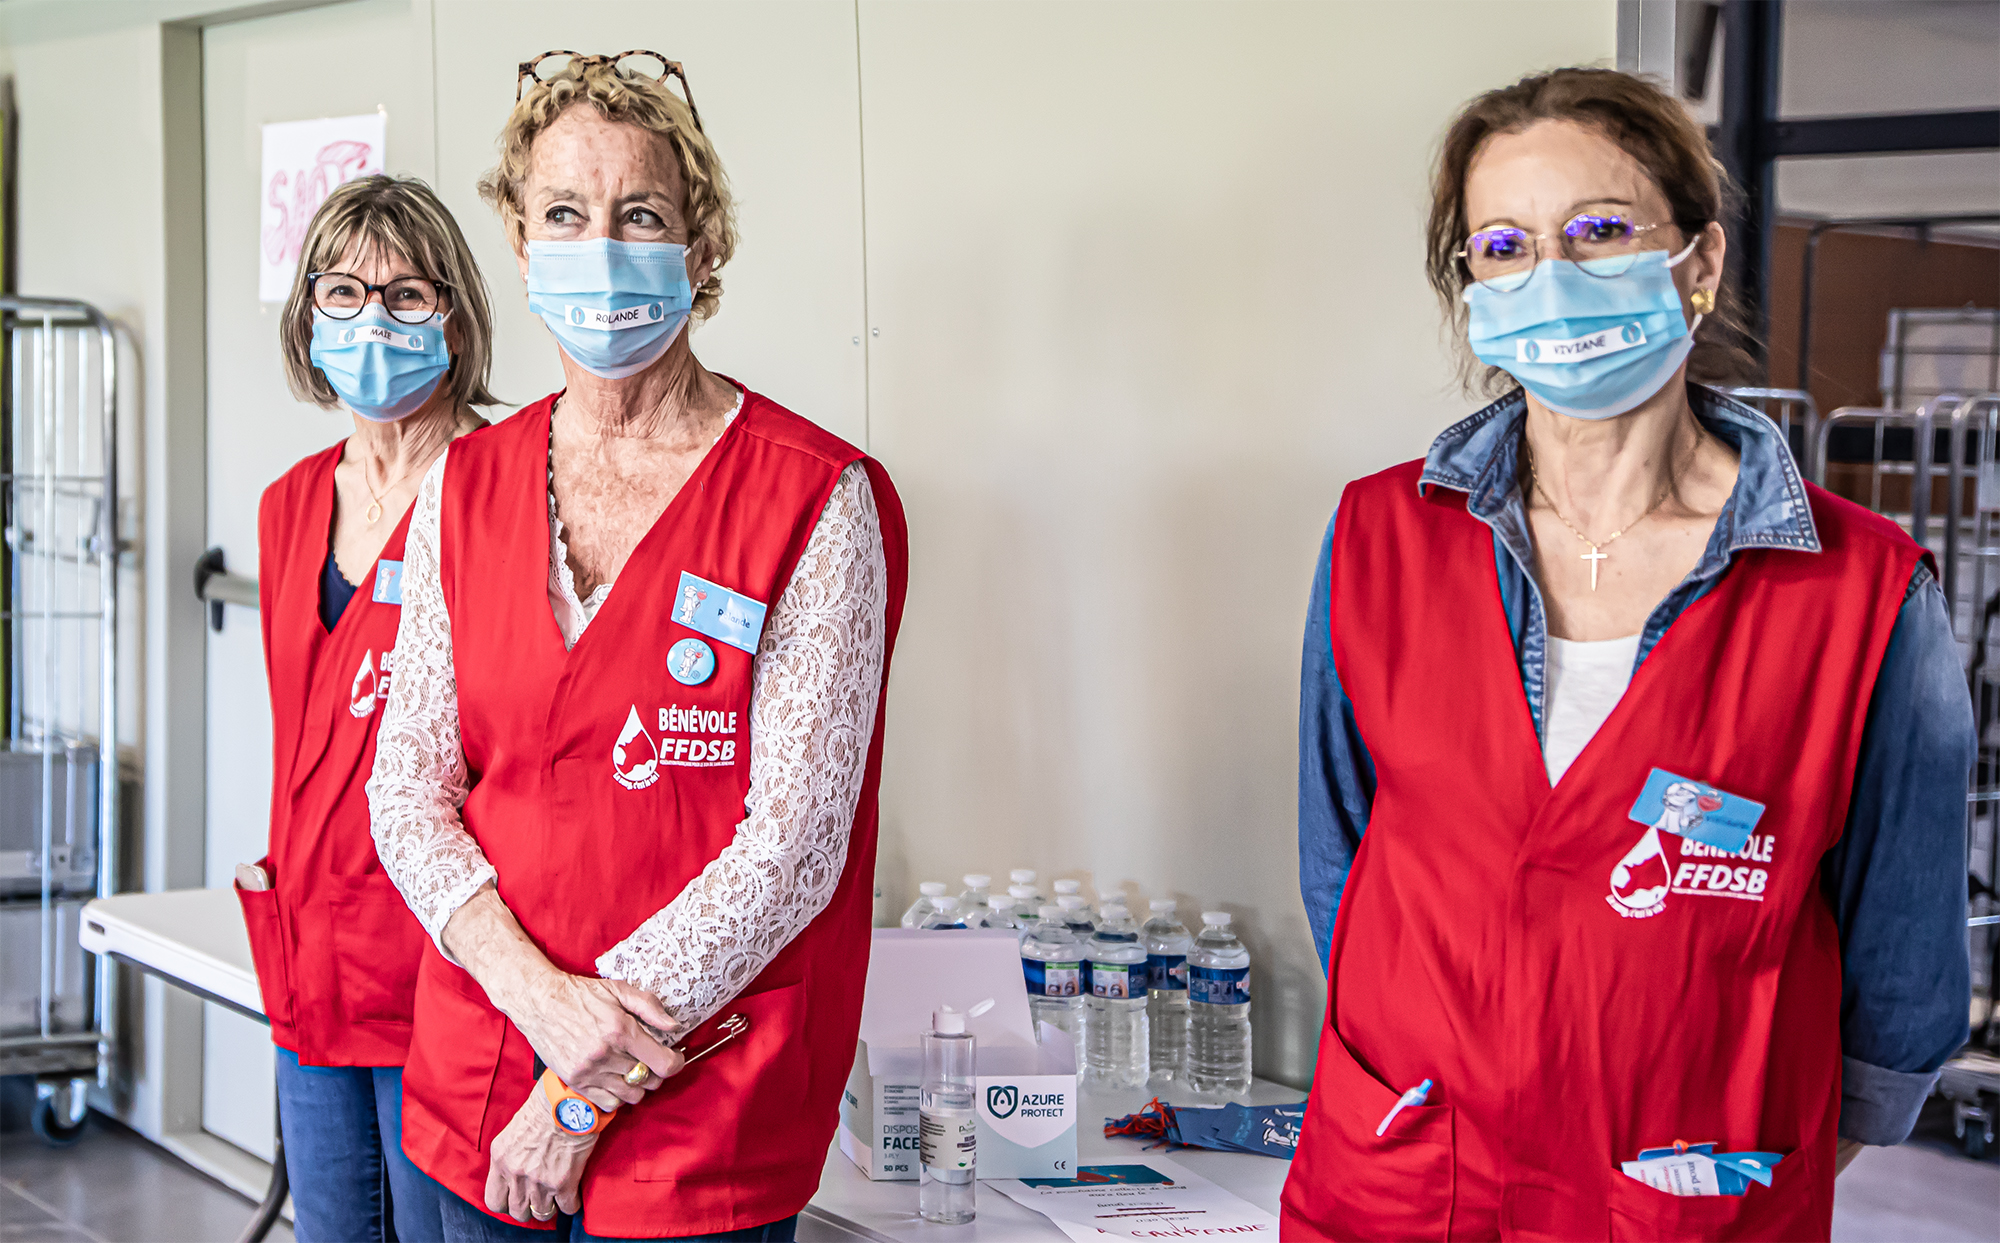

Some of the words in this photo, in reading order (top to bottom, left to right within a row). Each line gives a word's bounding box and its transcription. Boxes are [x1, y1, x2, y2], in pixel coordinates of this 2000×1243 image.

[596, 309, 639, 324] ROLANDE
[1554, 335, 1606, 355] VIVIANE
[658, 704, 737, 734] BÉNÉVOLE
[659, 738, 736, 761] FFDSB
[1673, 862, 1768, 893] FFDSB
[1021, 1094, 1064, 1106] AZURE
[1020, 1108, 1064, 1118] PROTECT
[883, 1125, 919, 1134] DISPOS
[883, 1137, 920, 1149] FACE
